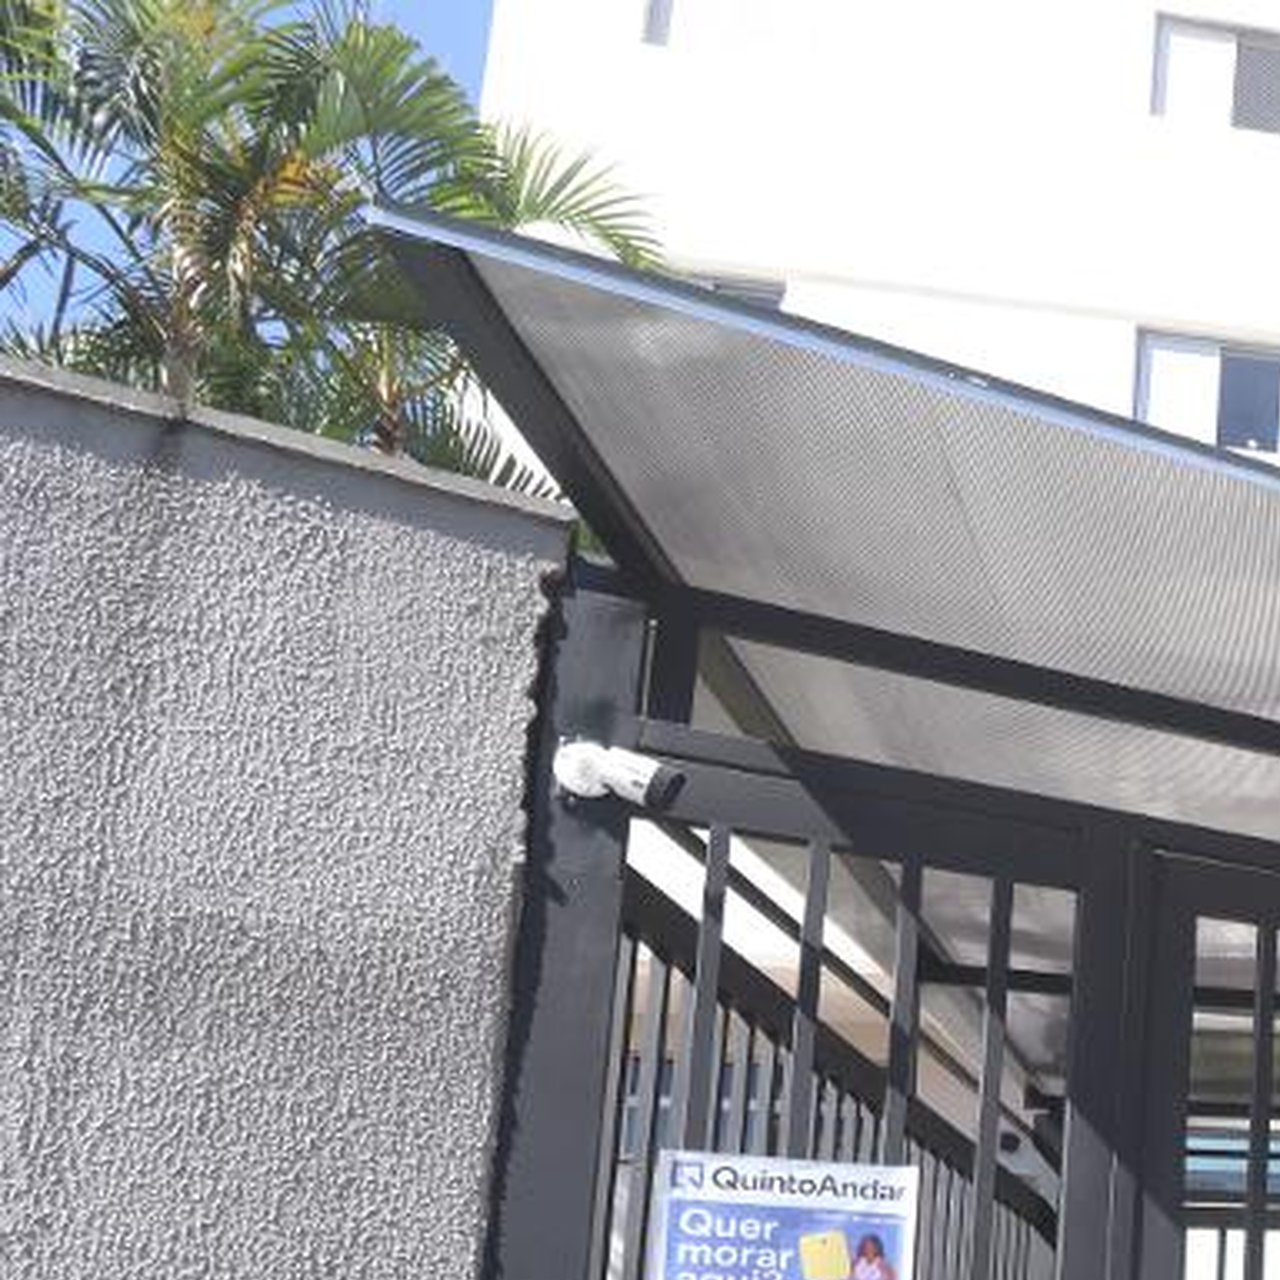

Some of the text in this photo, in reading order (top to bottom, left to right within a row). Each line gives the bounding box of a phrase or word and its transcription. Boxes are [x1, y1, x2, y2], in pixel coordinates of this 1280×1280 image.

[711, 1165, 907, 1202] QuintoAndar
[678, 1208, 779, 1241] Quer
[676, 1242, 796, 1271] morar
